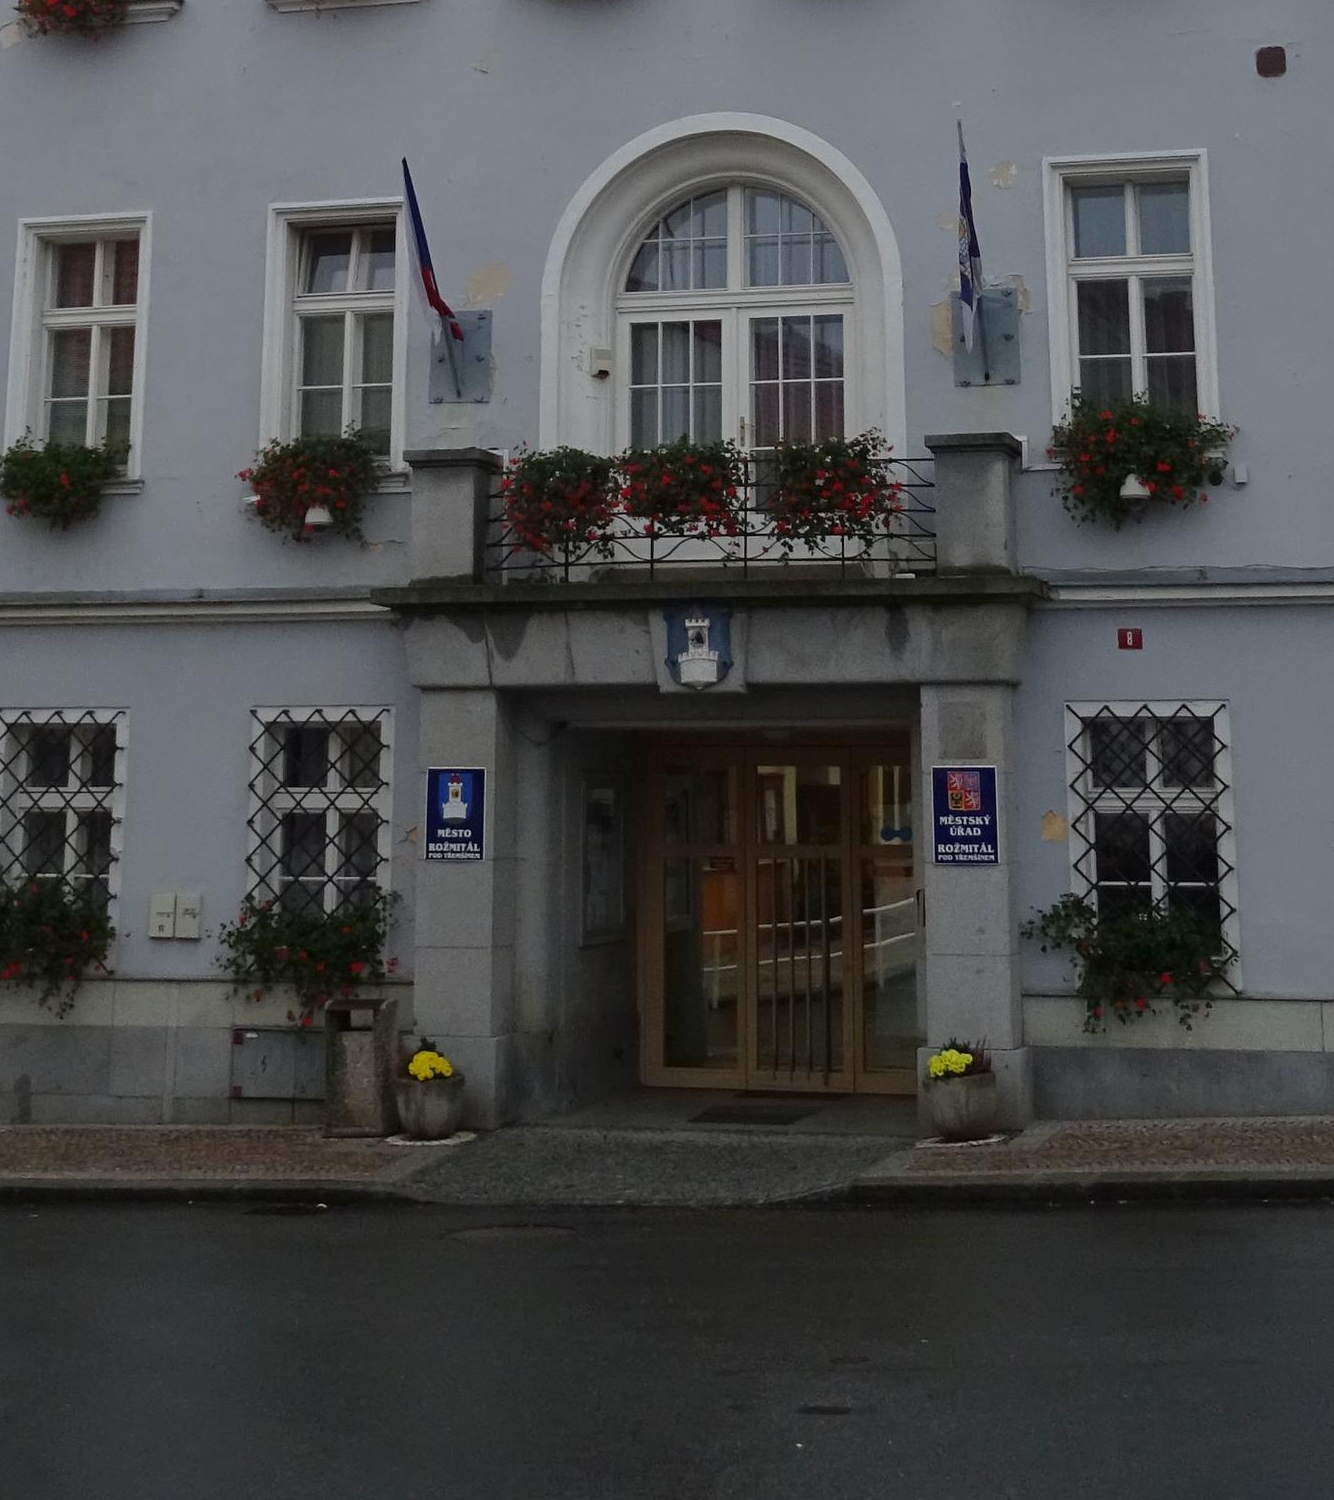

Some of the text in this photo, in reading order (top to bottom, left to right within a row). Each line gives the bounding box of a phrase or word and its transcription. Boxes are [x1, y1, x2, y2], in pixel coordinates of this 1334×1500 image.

[1127, 631, 1133, 646] 8
[939, 814, 991, 825] MĚSTSKÝ
[437, 827, 472, 838] MĚSTO
[949, 825, 981, 836] ÚŘAD
[428, 841, 480, 852] ROŽMITÁL
[938, 842, 995, 853] ROŽMITÁL
